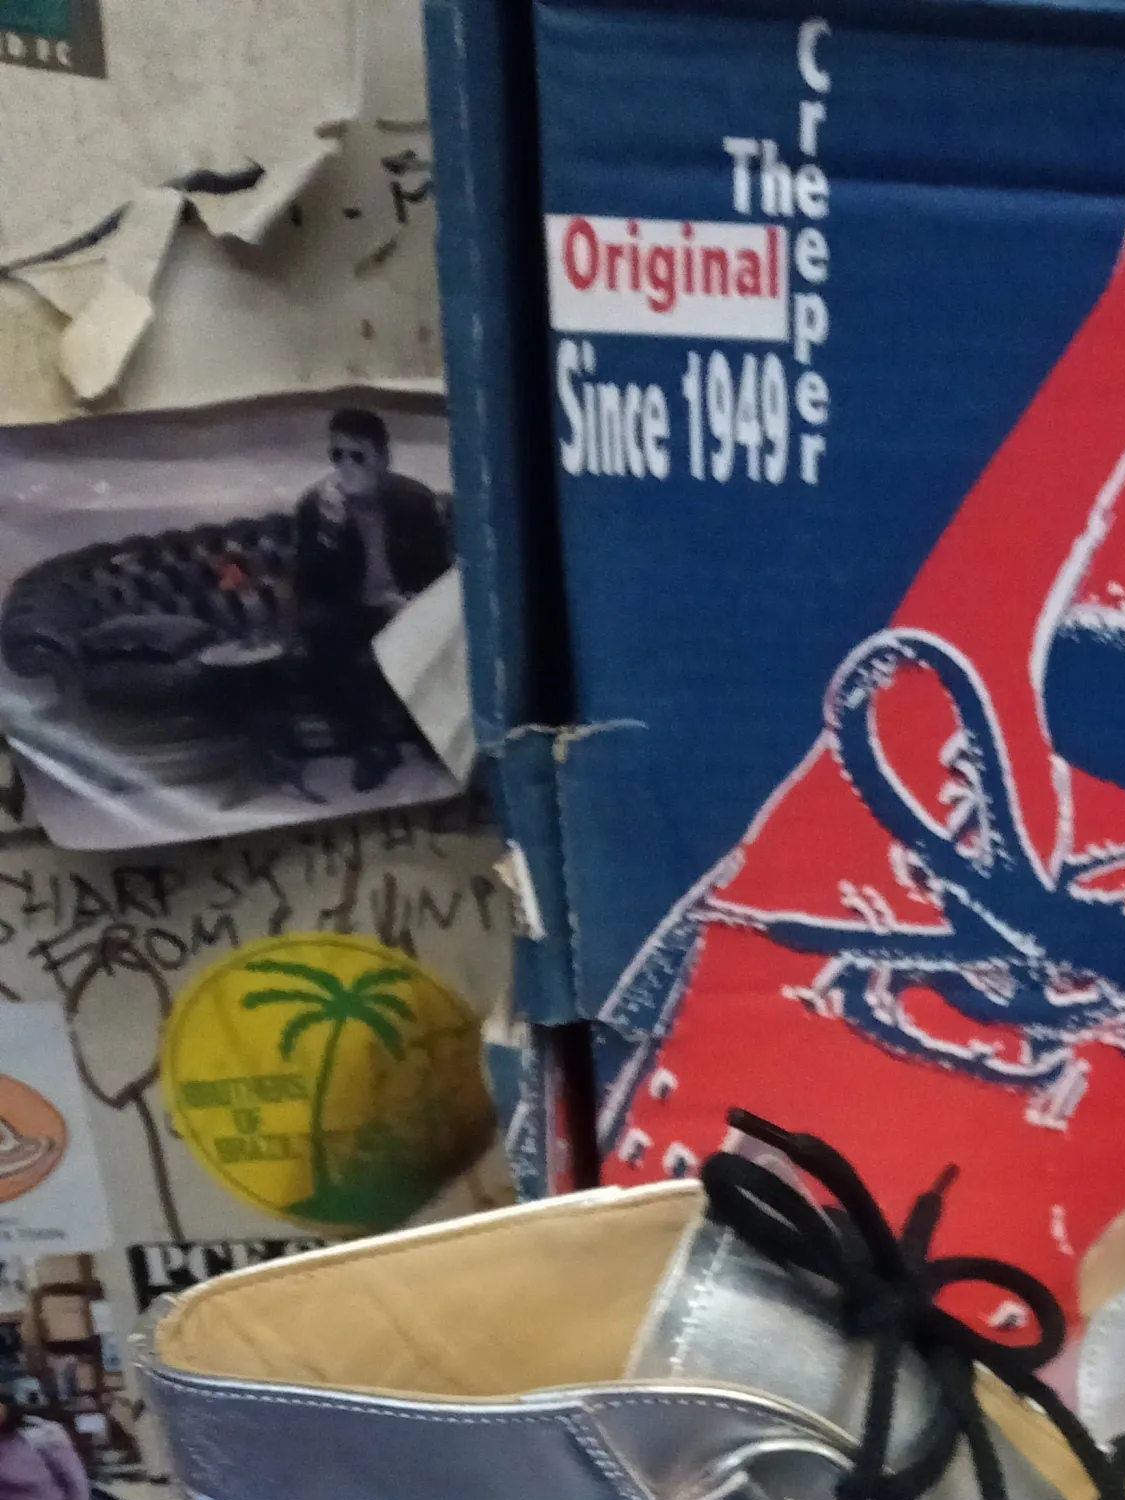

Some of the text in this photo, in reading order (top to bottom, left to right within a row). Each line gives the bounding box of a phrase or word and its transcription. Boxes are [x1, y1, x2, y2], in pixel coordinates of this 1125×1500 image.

[722, 135, 830, 219] The
[562, 216, 781, 314] Original
[794, 17, 831, 485] Creeper
[556, 338, 789, 486] Since 1949
